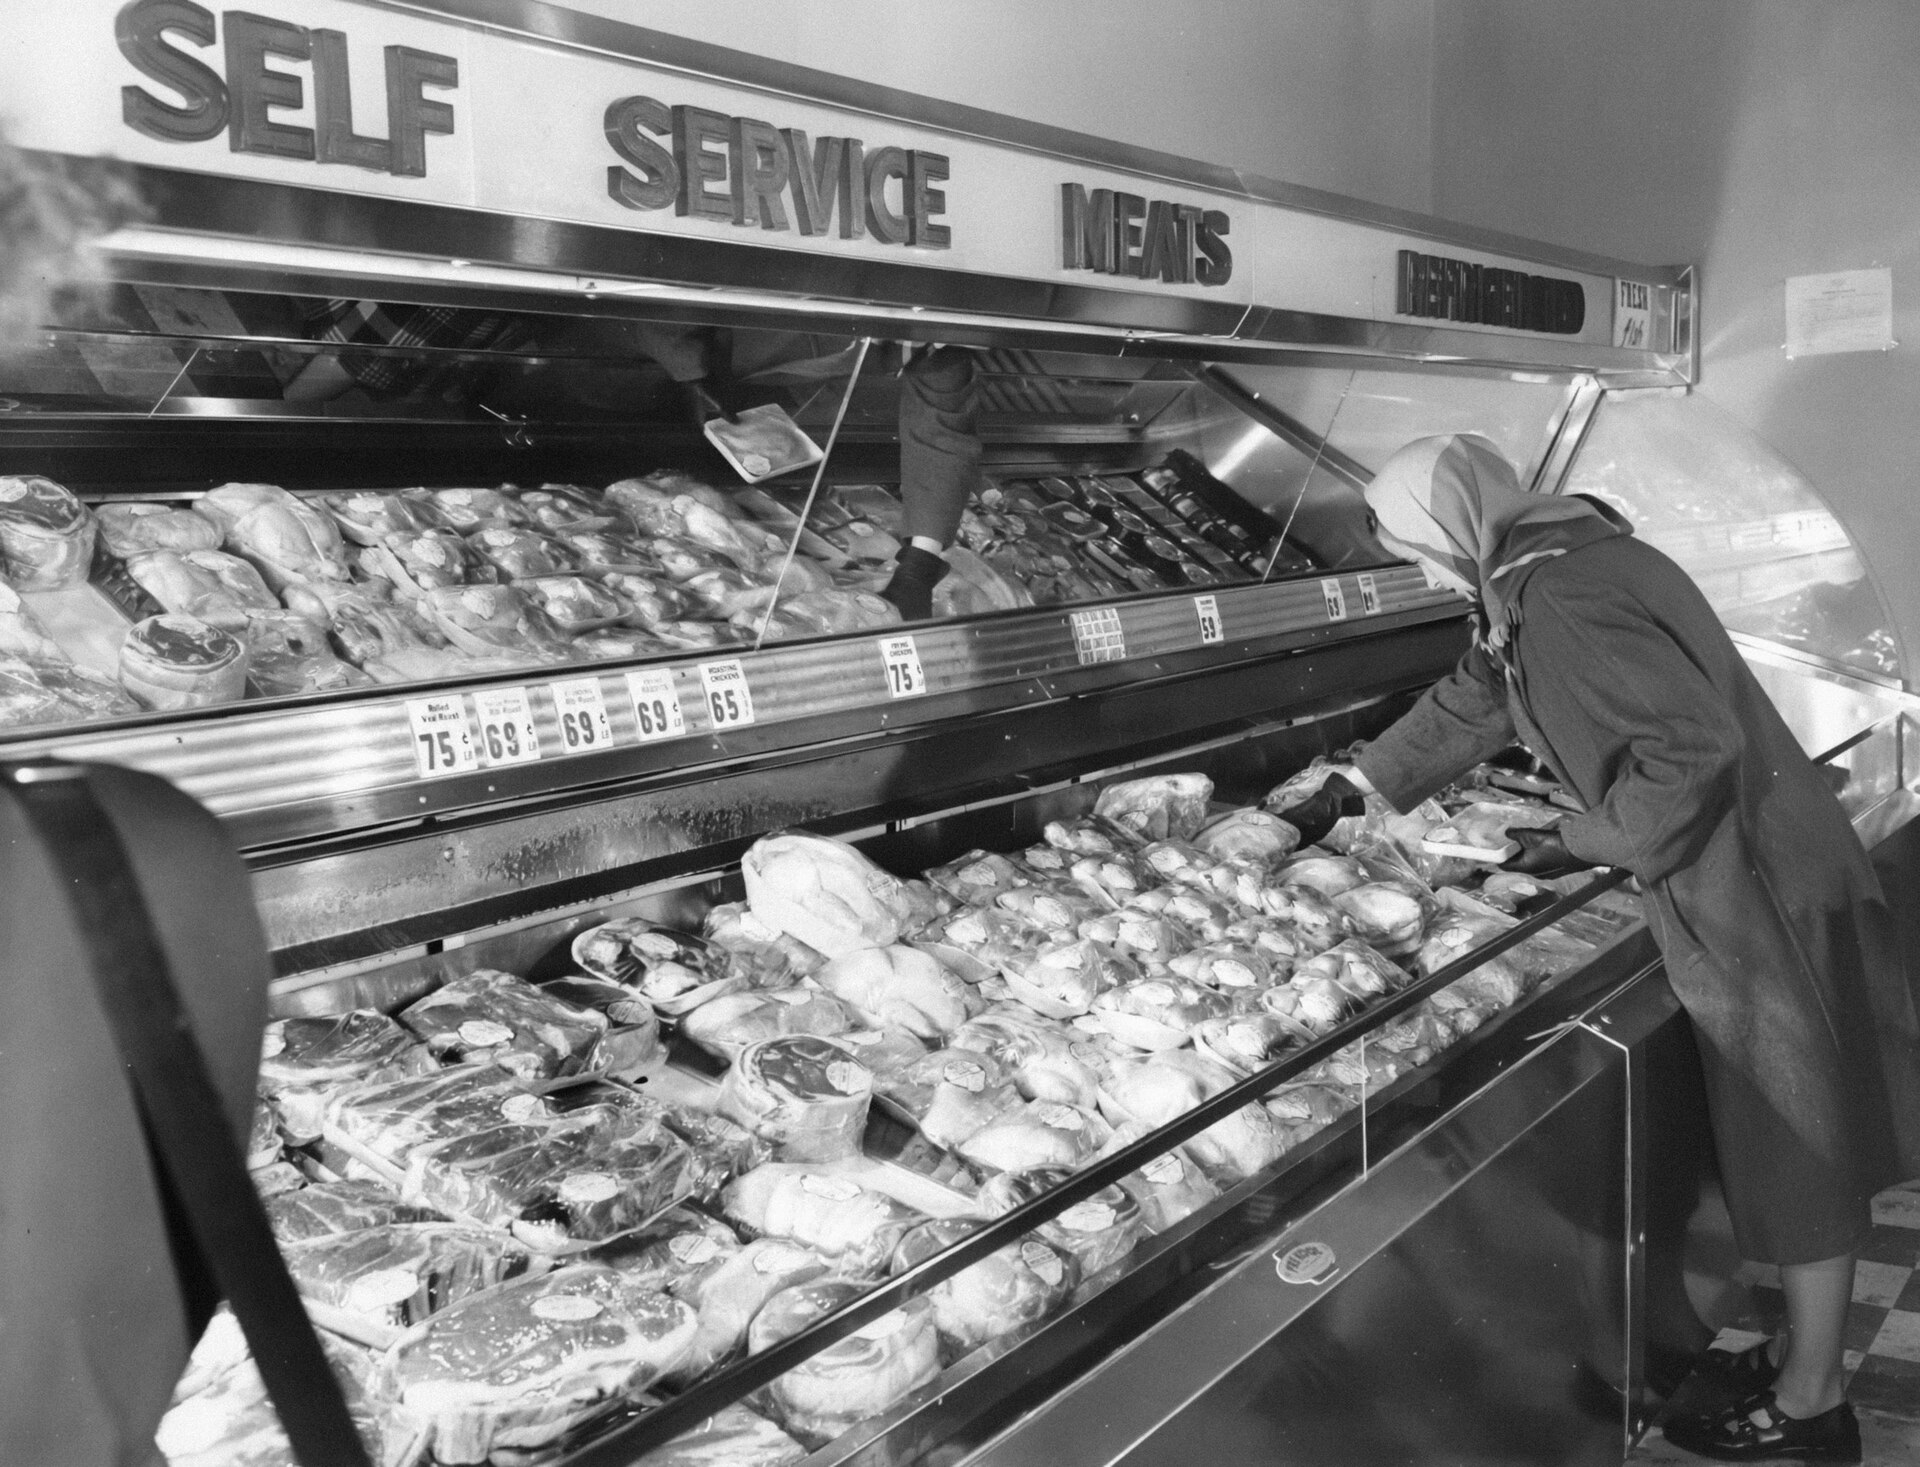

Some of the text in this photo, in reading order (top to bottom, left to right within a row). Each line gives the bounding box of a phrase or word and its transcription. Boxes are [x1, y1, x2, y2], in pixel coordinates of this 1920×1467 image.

[115, 0, 1233, 287] SELF SERVICE MEATS
[889, 663, 913, 692] 75
[638, 700, 667, 734] 69
[711, 689, 739, 723] 65
[486, 722, 520, 759] 69
[562, 711, 595, 747] 69
[418, 730, 456, 770] 75
